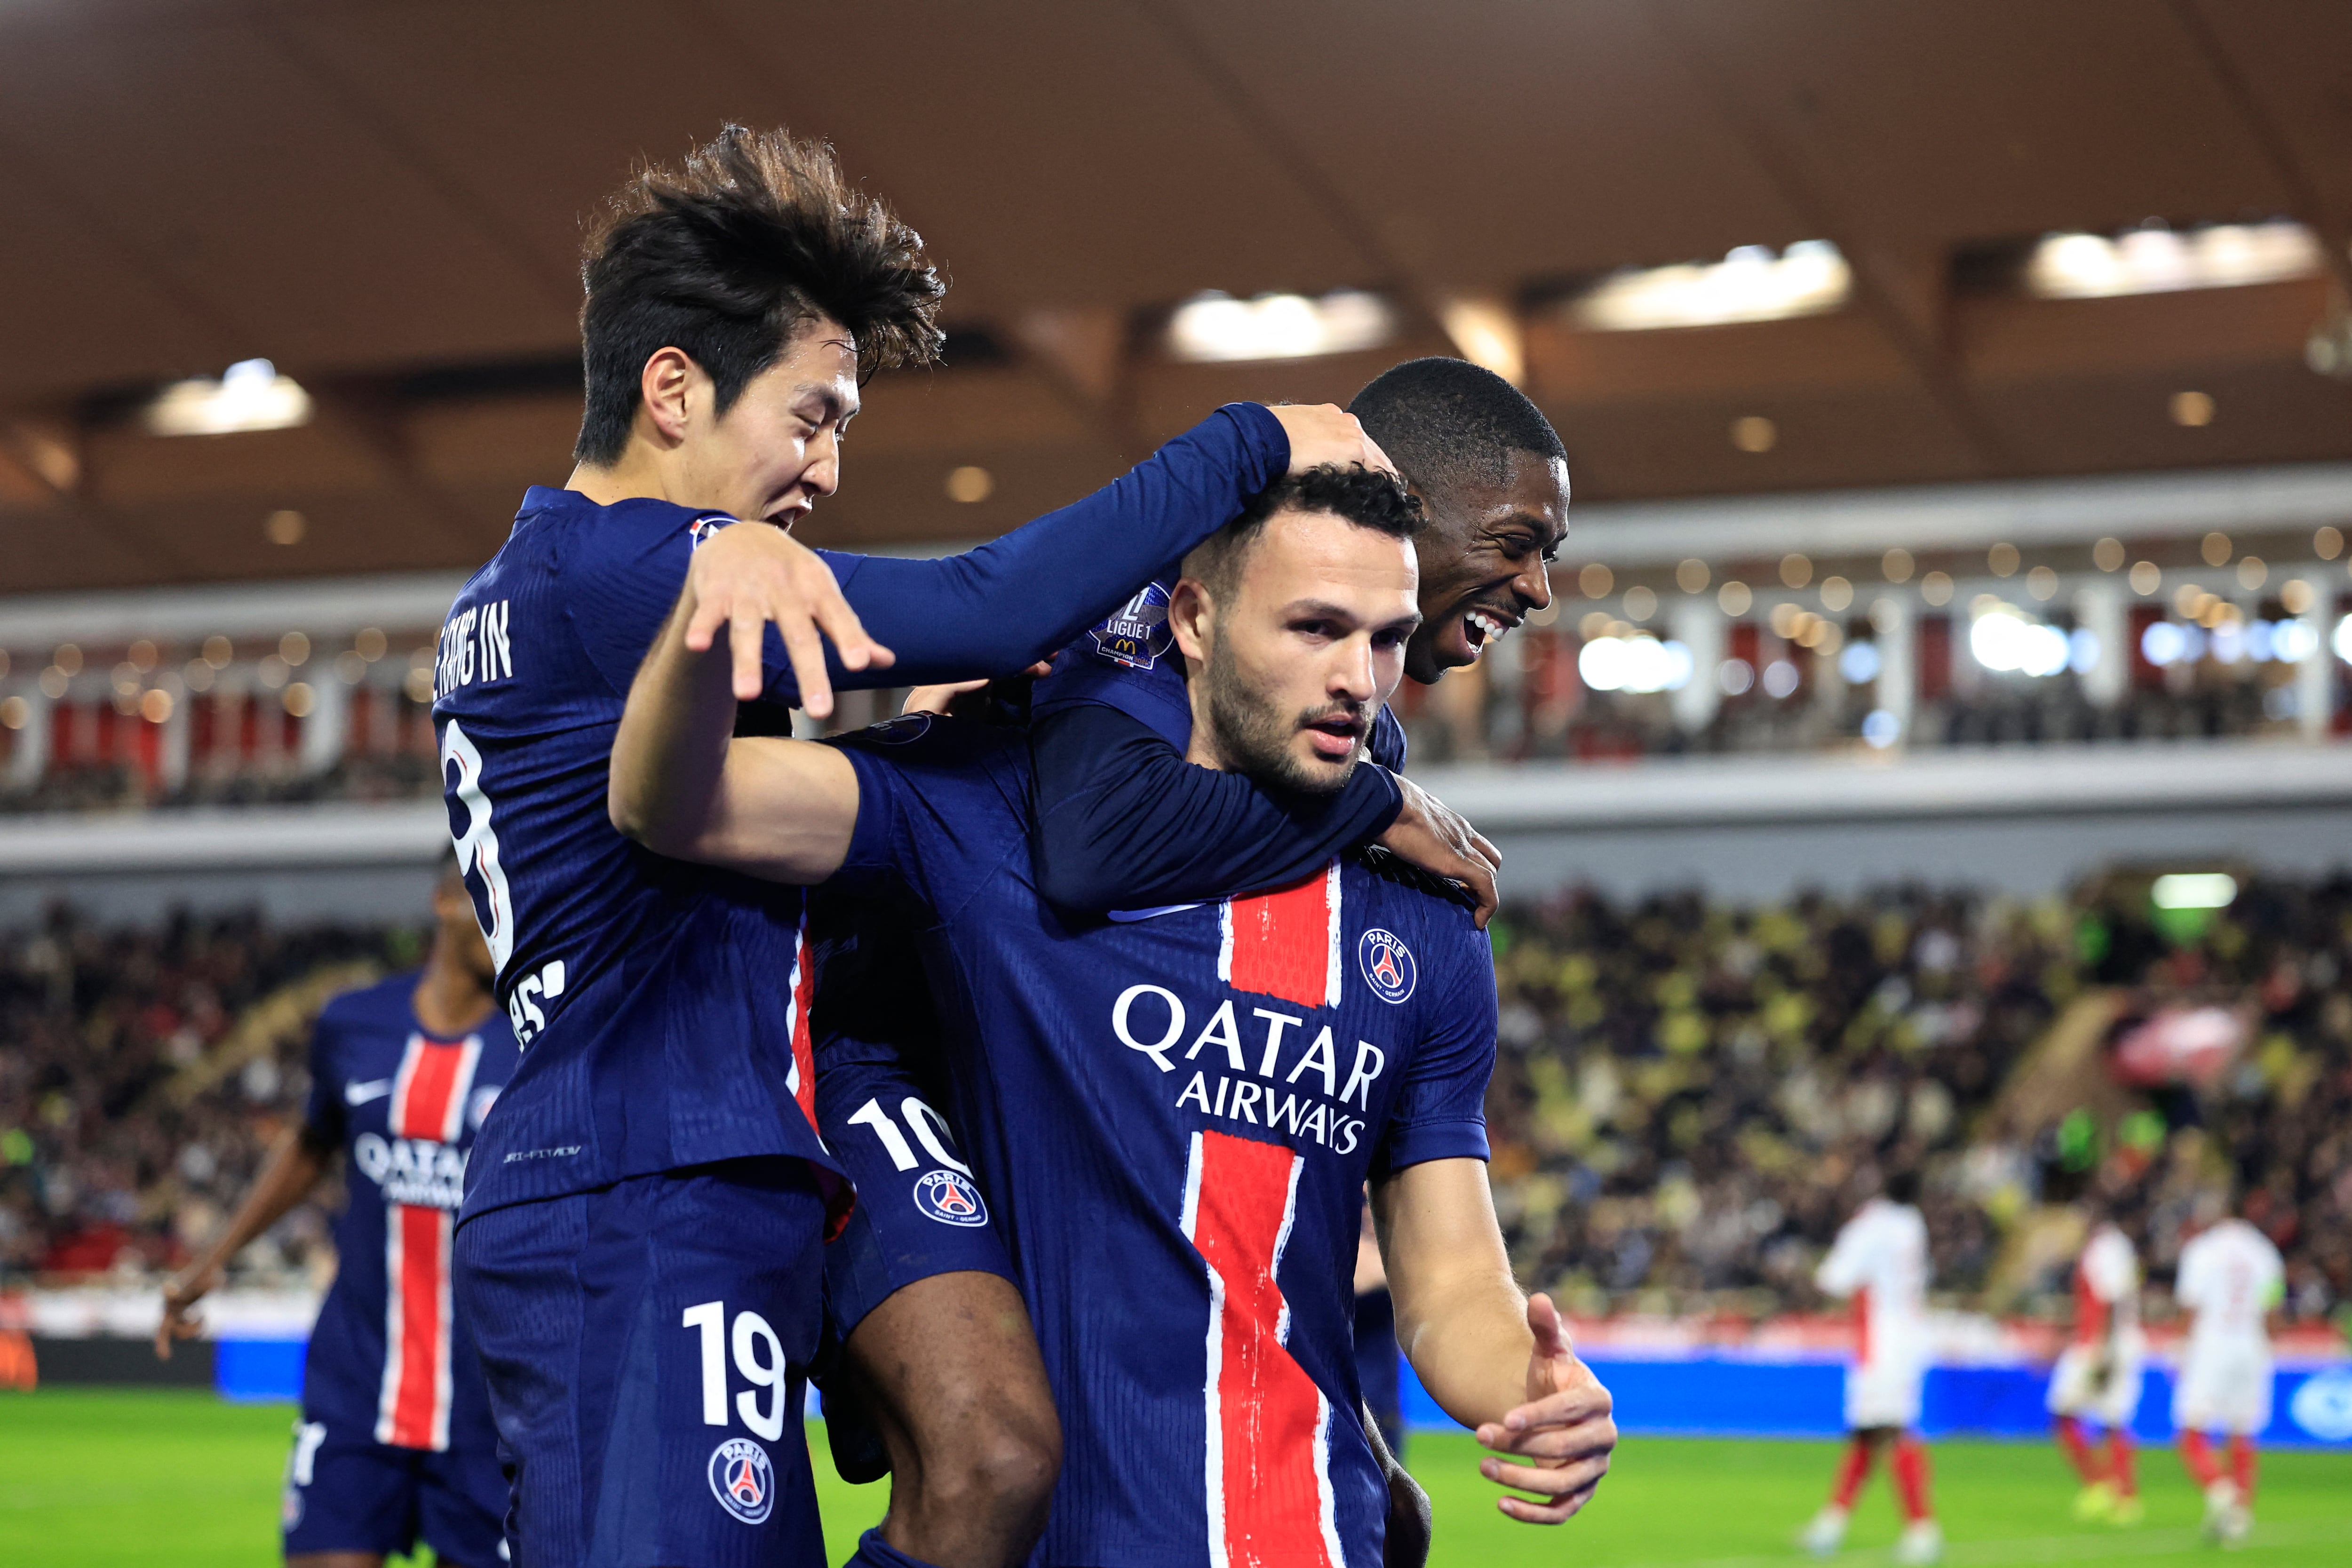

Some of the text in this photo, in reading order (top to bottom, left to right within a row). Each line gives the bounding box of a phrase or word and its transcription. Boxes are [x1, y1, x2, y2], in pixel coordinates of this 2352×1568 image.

[480, 599, 513, 683] IN
[1107, 620, 1151, 640] LIGUE 1
[1102, 647, 1134, 661] CHAMPION
[1367, 932, 1406, 958] PARIS
[1369, 973, 1405, 997] SAINT GERMAIN
[1112, 984, 1384, 1112] QATAR
[1176, 1071, 1365, 1154] AIRWAYS
[354, 1132, 472, 1188] QATA
[847, 1097, 975, 1181] 10
[922, 1173, 970, 1191] PARIS
[683, 1301, 786, 1441] 19
[721, 1443, 767, 1471] PARIS
